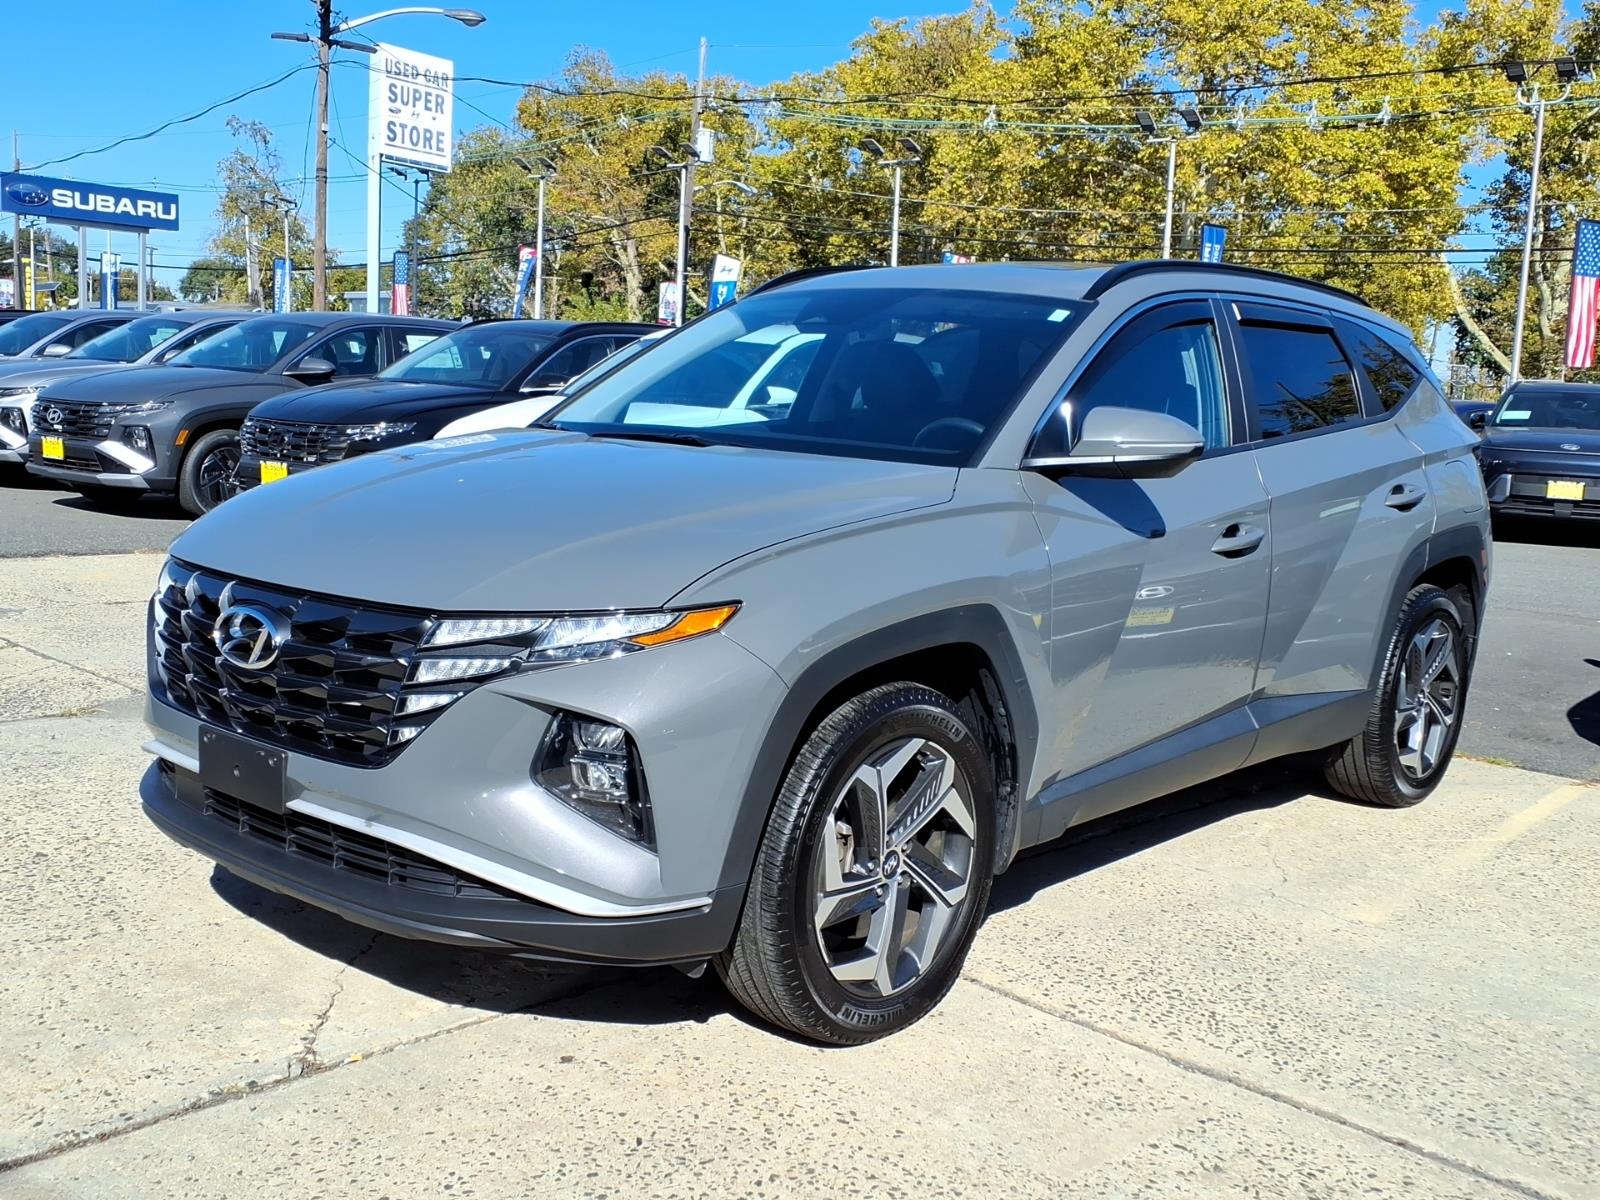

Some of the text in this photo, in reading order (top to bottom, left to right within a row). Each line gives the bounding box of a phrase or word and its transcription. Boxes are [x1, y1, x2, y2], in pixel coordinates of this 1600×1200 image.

[385, 57, 449, 88] USED CAR
[388, 82, 445, 115] SUPER
[386, 120, 445, 153] STORE
[52, 188, 177, 220] SUBARU
